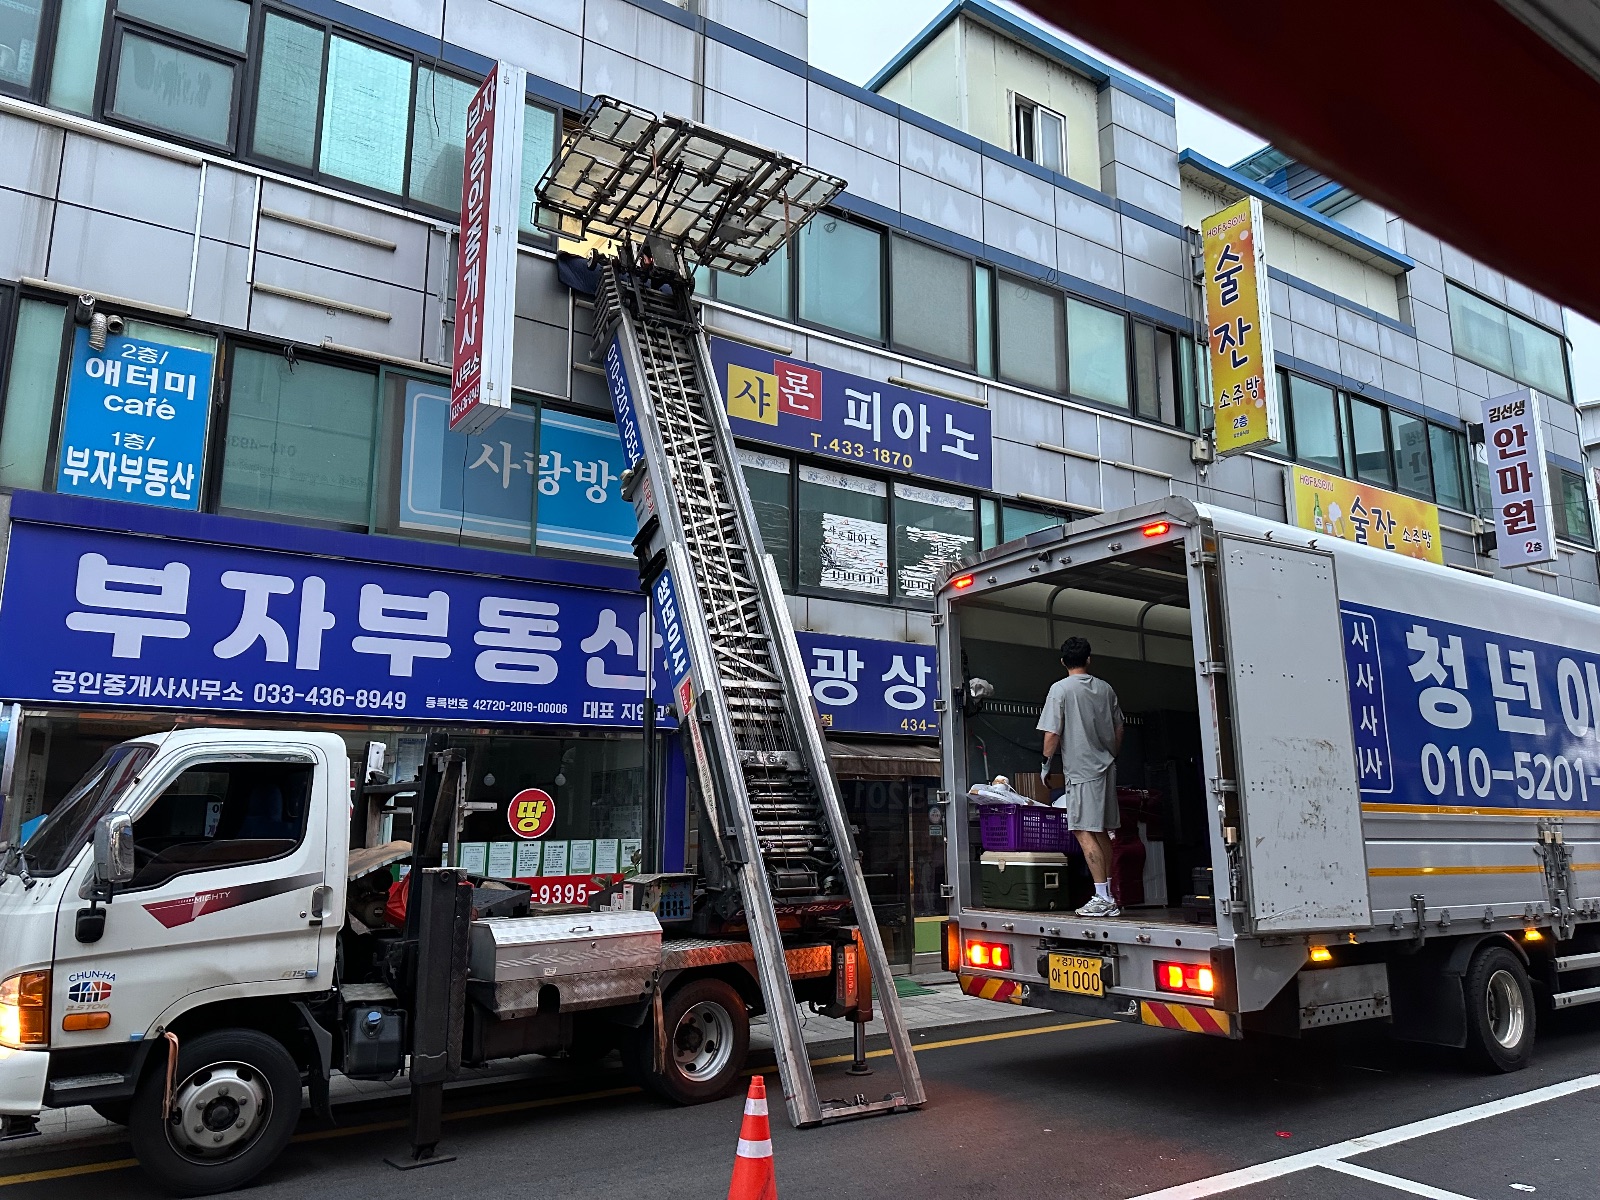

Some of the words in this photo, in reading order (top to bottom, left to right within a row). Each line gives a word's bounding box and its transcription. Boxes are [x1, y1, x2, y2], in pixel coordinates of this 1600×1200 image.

[1214, 244, 1251, 369] 술잔
[85, 357, 196, 401] 애터미
[454, 352, 480, 392] 사무소
[104, 394, 176, 420] café
[1219, 376, 1261, 409] 소주방
[1488, 400, 1525, 423] 김선생
[734, 370, 815, 419] 샤론
[843, 388, 979, 461] 피아노
[64, 445, 195, 500] 부자부동산
[469, 441, 618, 504] 사랑방
[1493, 424, 1537, 536] 안마원
[1349, 496, 1396, 550] 술잔
[1402, 527, 1432, 549] 소주방
[1525, 541, 1542, 554] 2층
[65, 552, 665, 691] 부자부동산
[657, 575, 687, 676] 청년이사
[52, 670, 243, 702] 공인중개사사무소
[253, 683, 407, 710] 033-436-8949
[425, 697, 468, 710] 등록번호
[473, 699, 568, 715] 42720-2019-00006
[583, 701, 614, 719] 대표
[900, 718, 939, 731] 434-
[516, 800, 549, 832] 땅
[194, 891, 231, 903] MIGHTY
[68, 970, 116, 982] CHUN-HA
[1061, 956, 1075, 968] 경기
[1076, 958, 1089, 969] 90
